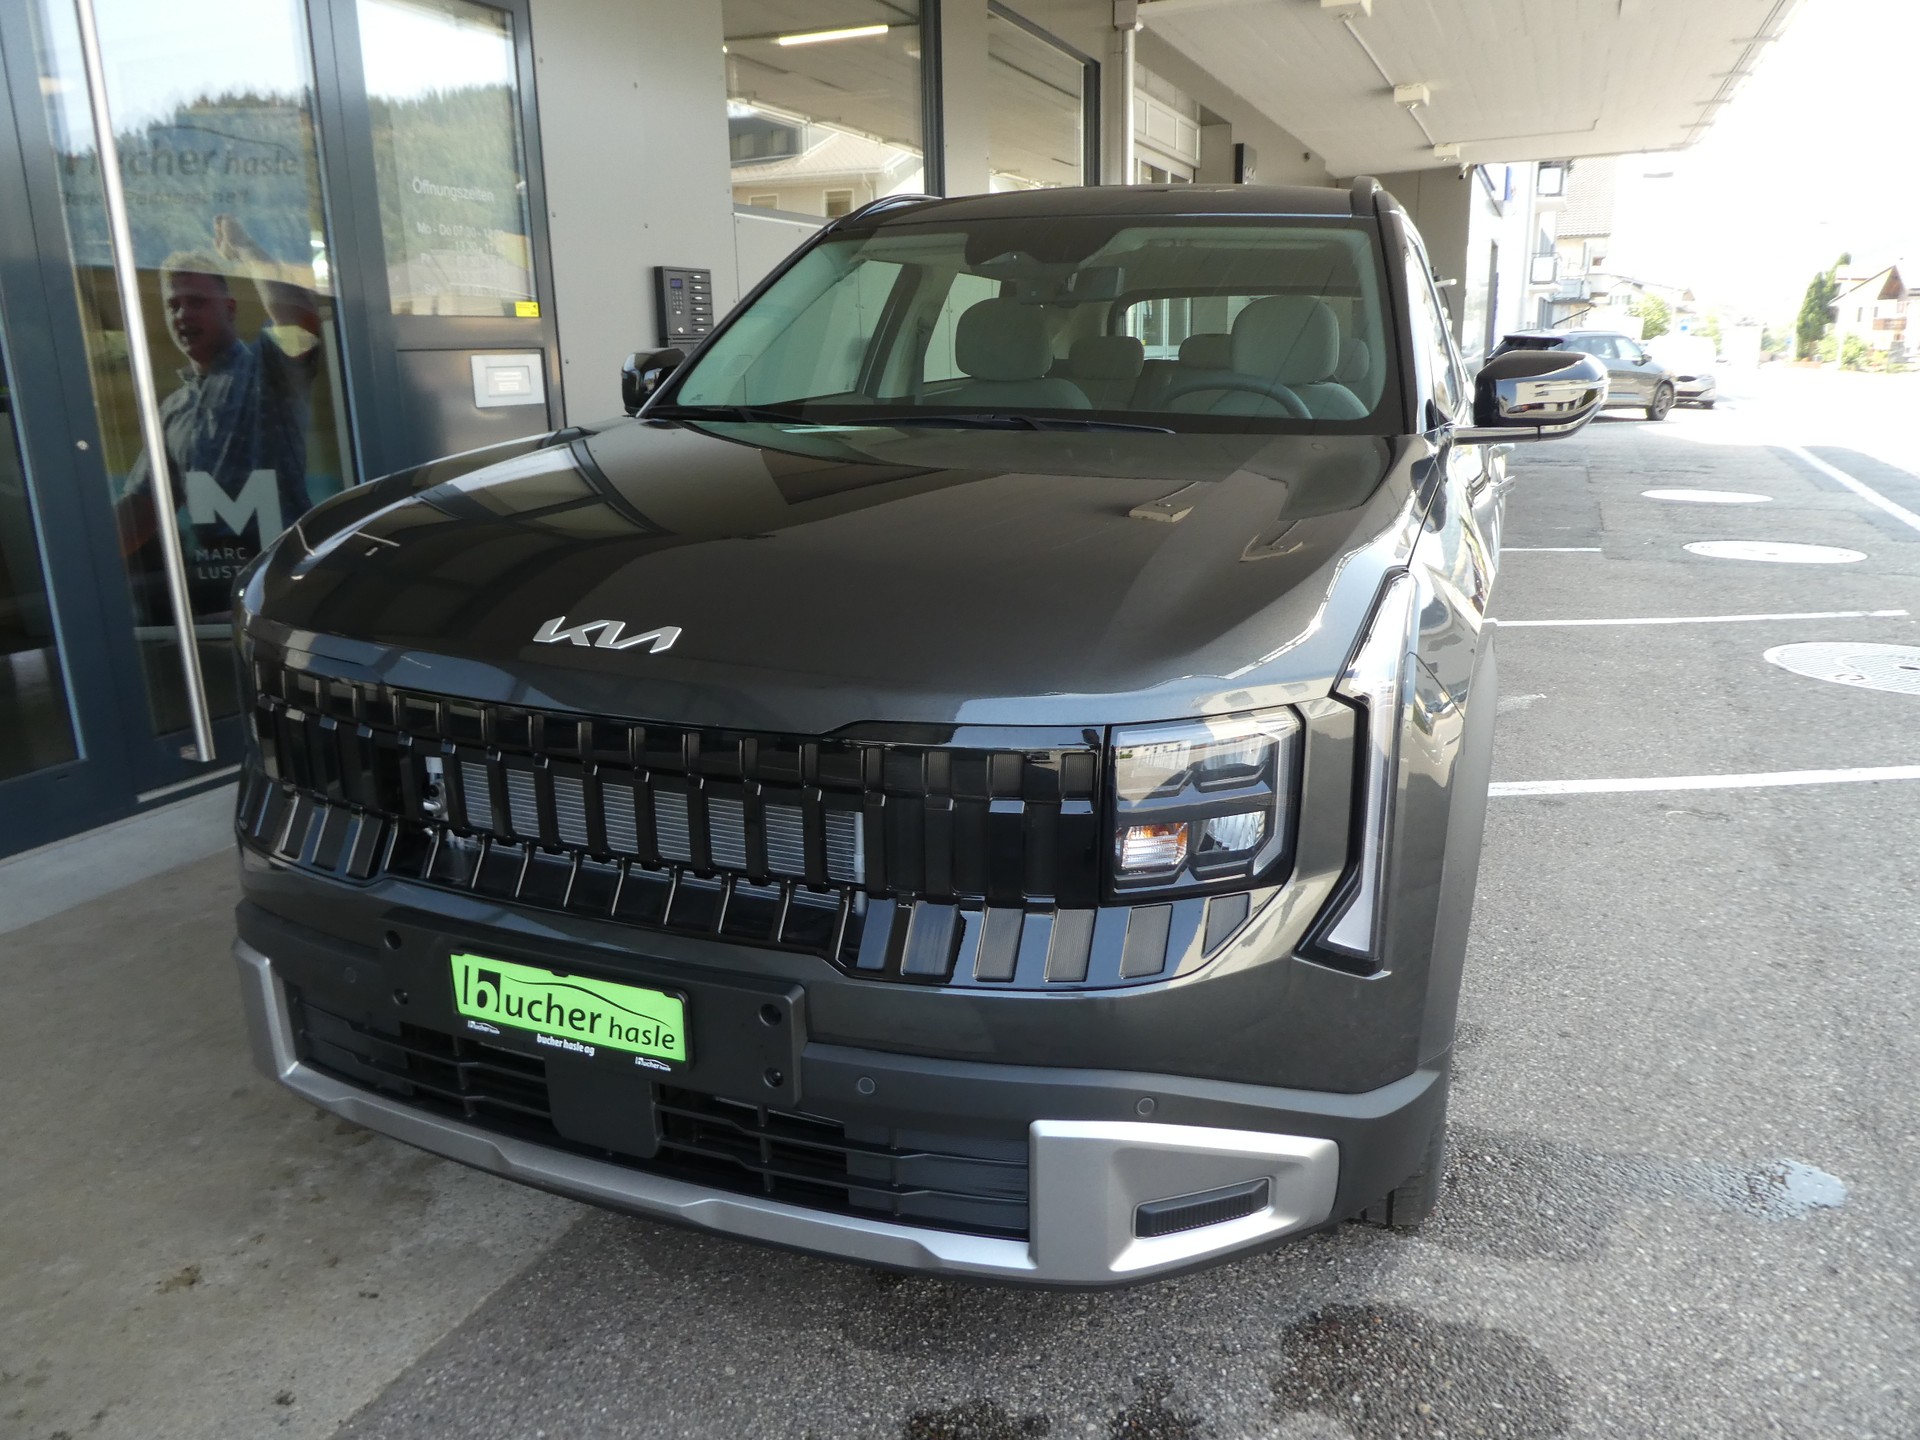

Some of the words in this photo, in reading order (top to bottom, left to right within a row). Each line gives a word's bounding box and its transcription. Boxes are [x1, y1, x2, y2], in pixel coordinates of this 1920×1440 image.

[413, 178, 494, 202] Öffnungszeiten
[416, 221, 432, 235] Mo
[438, 223, 452, 236] Do
[195, 547, 246, 562] MARC
[533, 615, 682, 654] KIA
[463, 965, 602, 1034] bucher
[609, 1017, 675, 1050] hasle
[536, 1033, 563, 1047] bucher
[562, 1038, 584, 1052] hasle
[583, 1045, 595, 1056] ag
